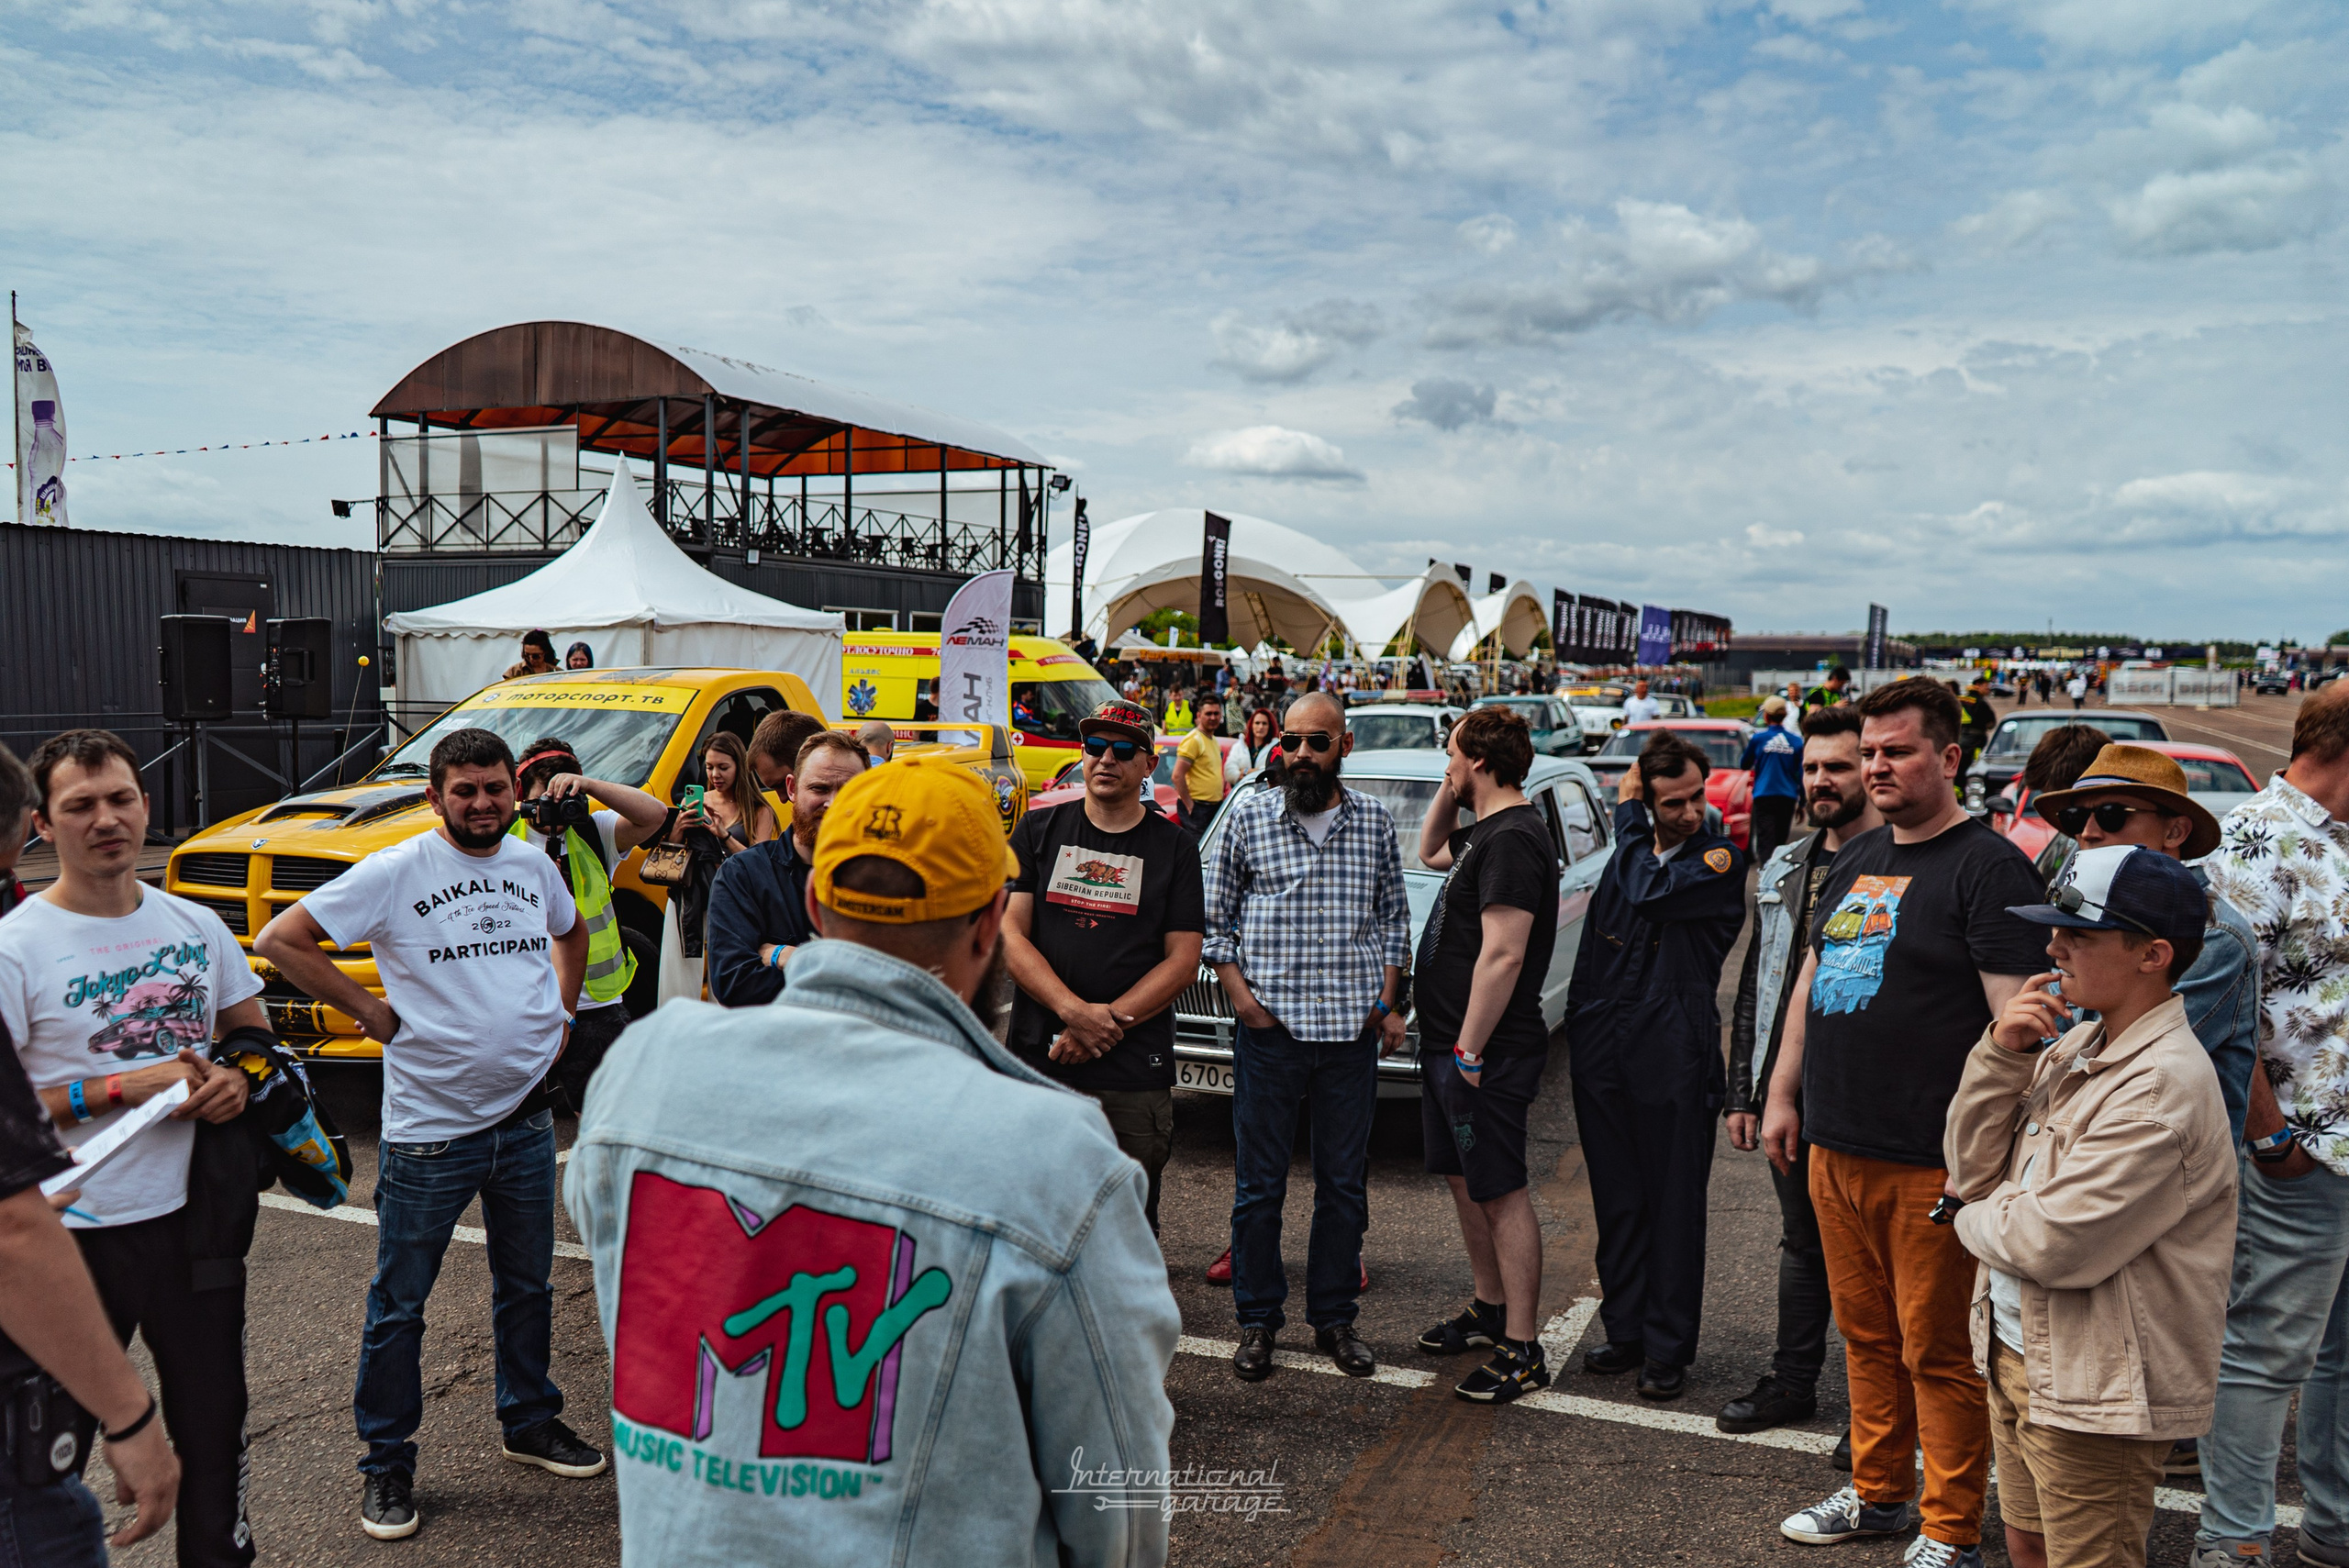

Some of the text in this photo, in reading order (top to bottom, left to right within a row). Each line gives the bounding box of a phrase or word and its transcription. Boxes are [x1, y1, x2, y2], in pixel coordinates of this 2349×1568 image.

[1101, 706, 1143, 722] ДРИФТ
[413, 879, 540, 917] BAIKAL MILE
[1056, 882, 1131, 900] SIBERIAN REPUBLIC
[836, 901, 905, 917] AMSTERDAM
[89, 938, 165, 955] THE ORIGINAL
[429, 937, 548, 963] PARTICIPANT
[1848, 954, 1881, 977] MILE
[612, 1170, 952, 1465] MTV
